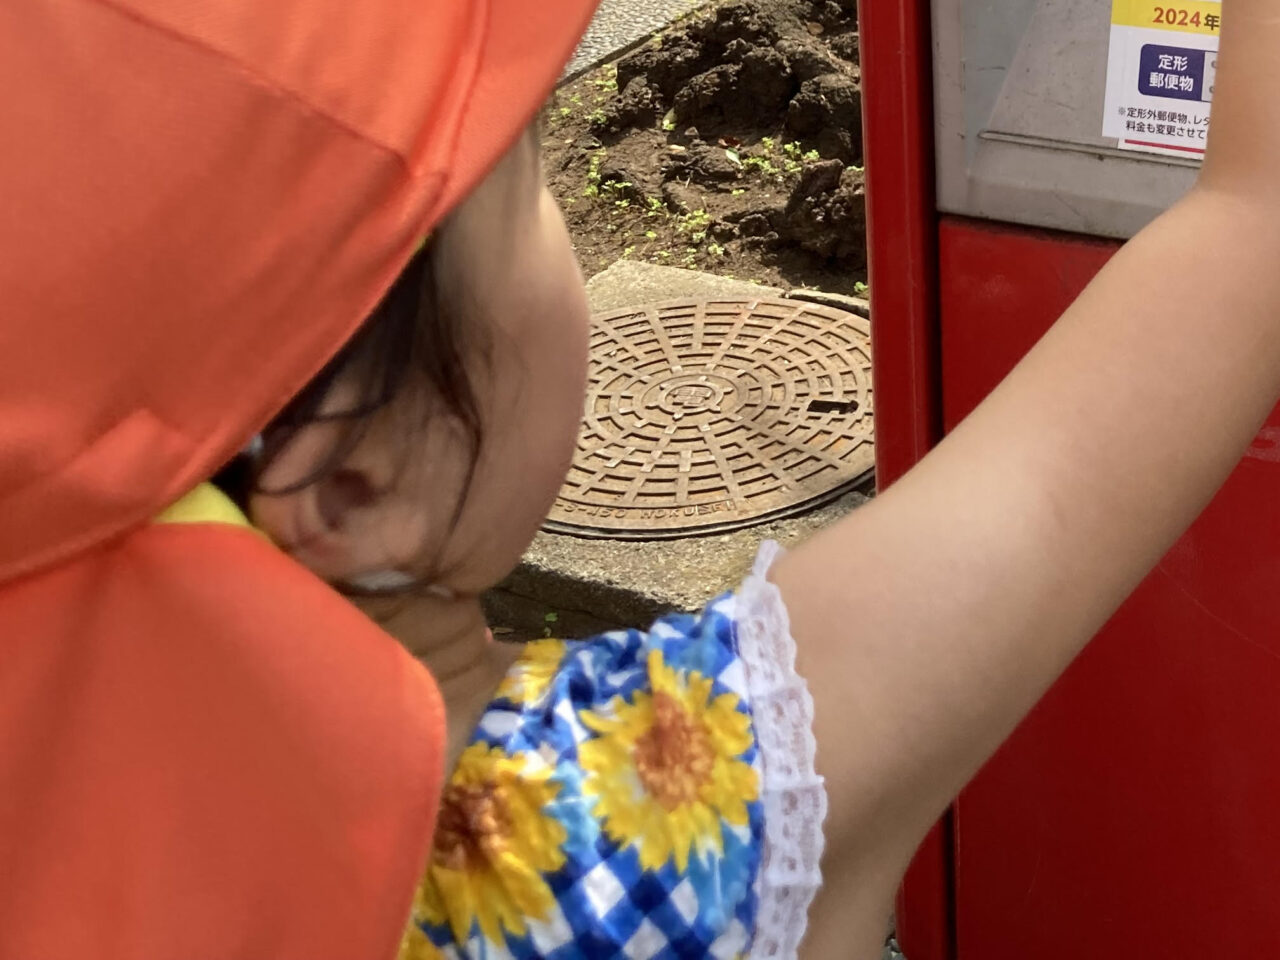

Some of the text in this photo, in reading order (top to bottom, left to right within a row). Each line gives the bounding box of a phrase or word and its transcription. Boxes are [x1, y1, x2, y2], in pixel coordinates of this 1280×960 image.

[1152, 6, 1221, 31] 2024年
[1158, 54, 1188, 71] 定形
[1149, 72, 1194, 92] 郵便物
[1126, 120, 1205, 140] 料金も変更させて
